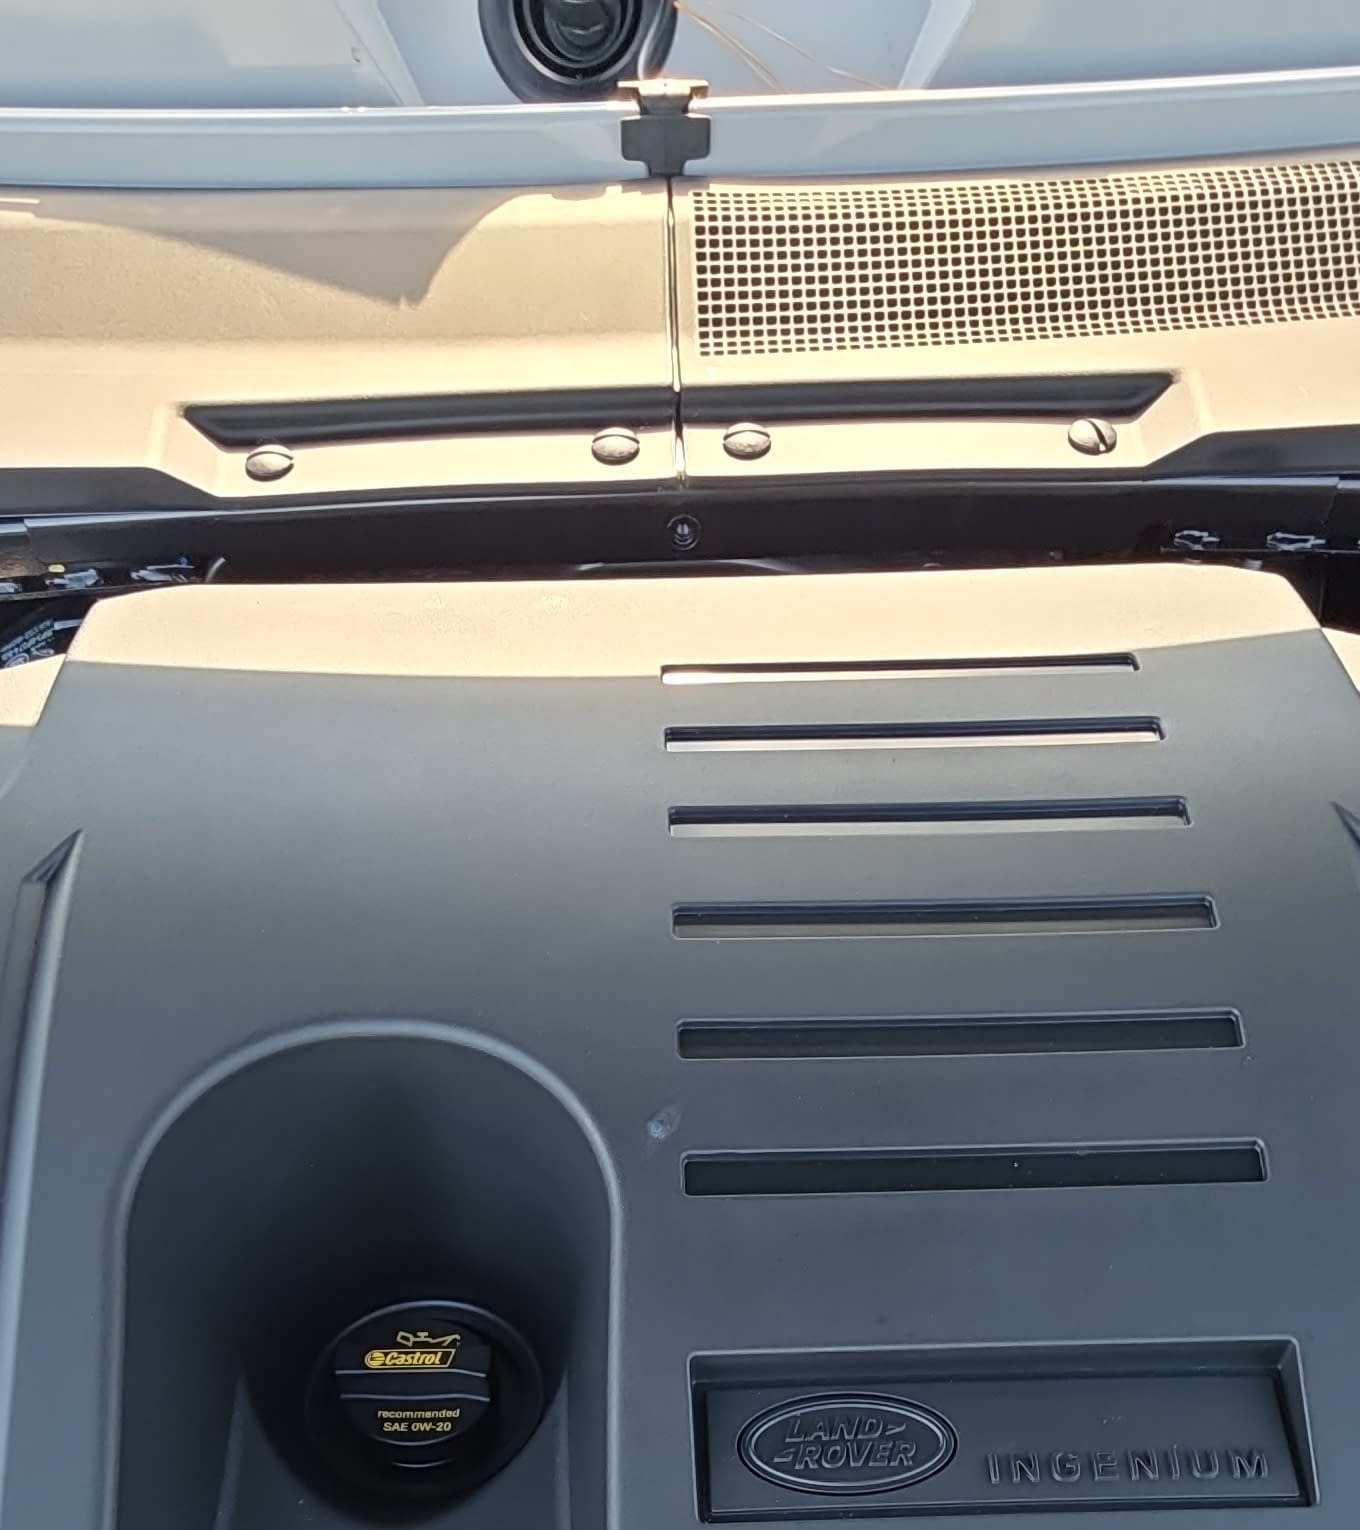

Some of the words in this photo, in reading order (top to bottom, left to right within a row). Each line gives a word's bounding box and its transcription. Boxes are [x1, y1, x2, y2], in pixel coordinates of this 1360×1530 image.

[384, 1351, 443, 1366] Castrol
[377, 1408, 461, 1420] recommended
[382, 1421, 409, 1432] SAE
[411, 1421, 453, 1432] 0W-20
[784, 1415, 886, 1443] LAND
[794, 1441, 917, 1471] ROVER
[985, 1446, 1271, 1486] INGENIUM
